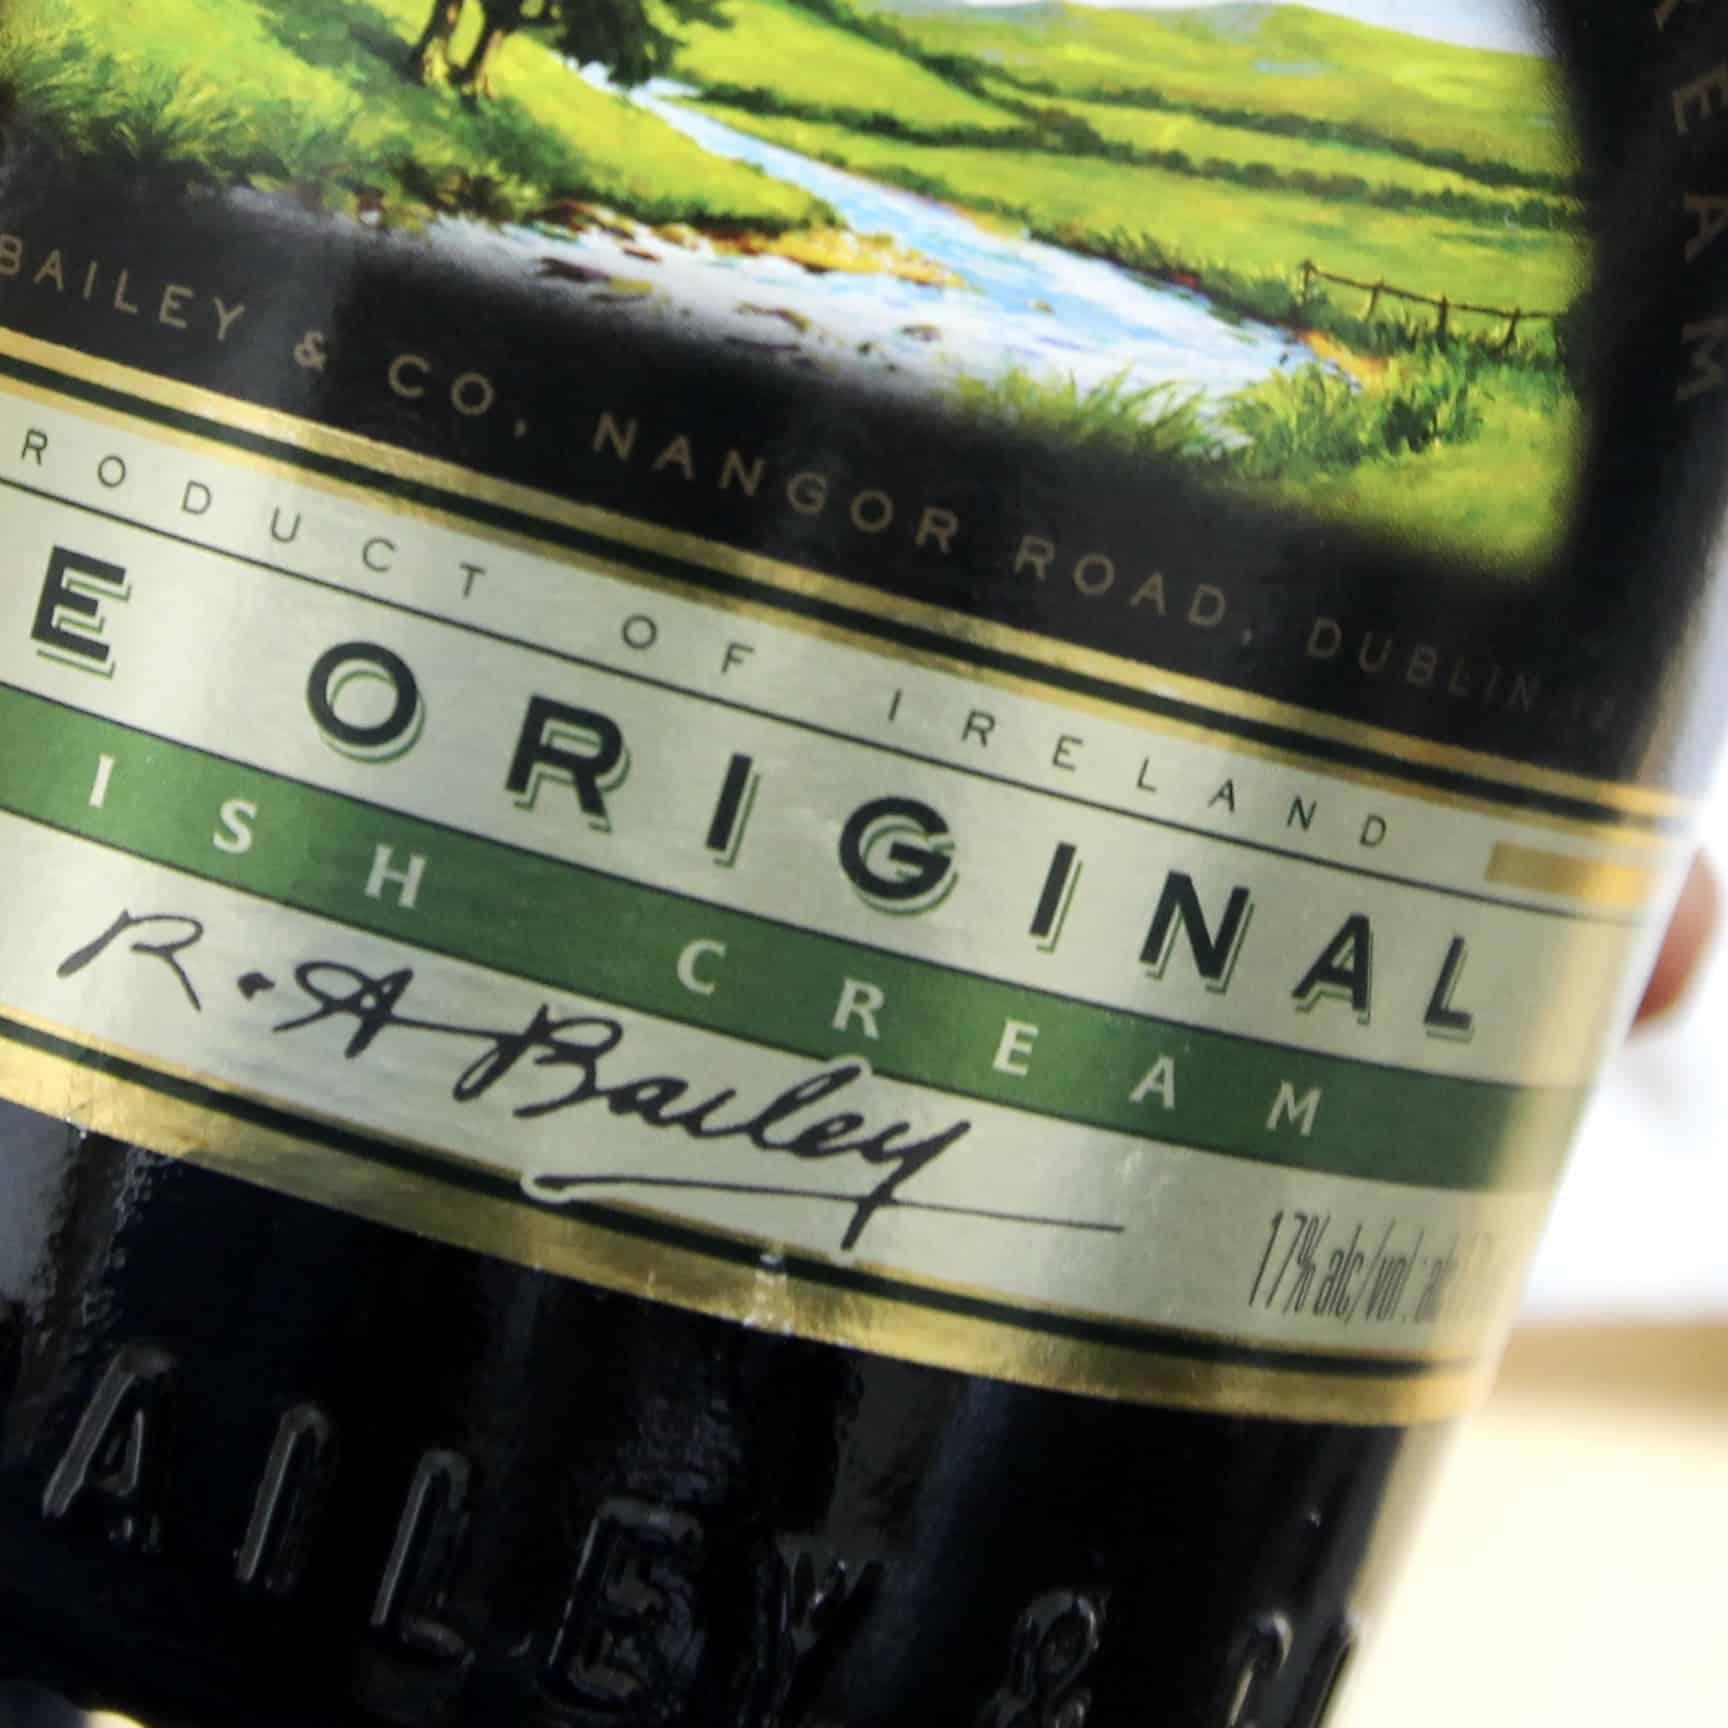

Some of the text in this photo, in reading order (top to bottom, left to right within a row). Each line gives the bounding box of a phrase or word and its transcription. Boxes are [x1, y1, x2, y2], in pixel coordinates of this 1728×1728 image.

[293, 330, 328, 371] &
[591, 412, 960, 553] NANGOR
[1013, 534, 1256, 647] ROAD,
[1305, 615, 1542, 711] DUBLIN
[306, 641, 1474, 1039] ORIGINAL
[621, 613, 756, 675] OF
[888, 688, 1388, 849] IRELAND
[454, 1003, 974, 1251] Bailey
[674, 938, 1322, 1137] CREAM
